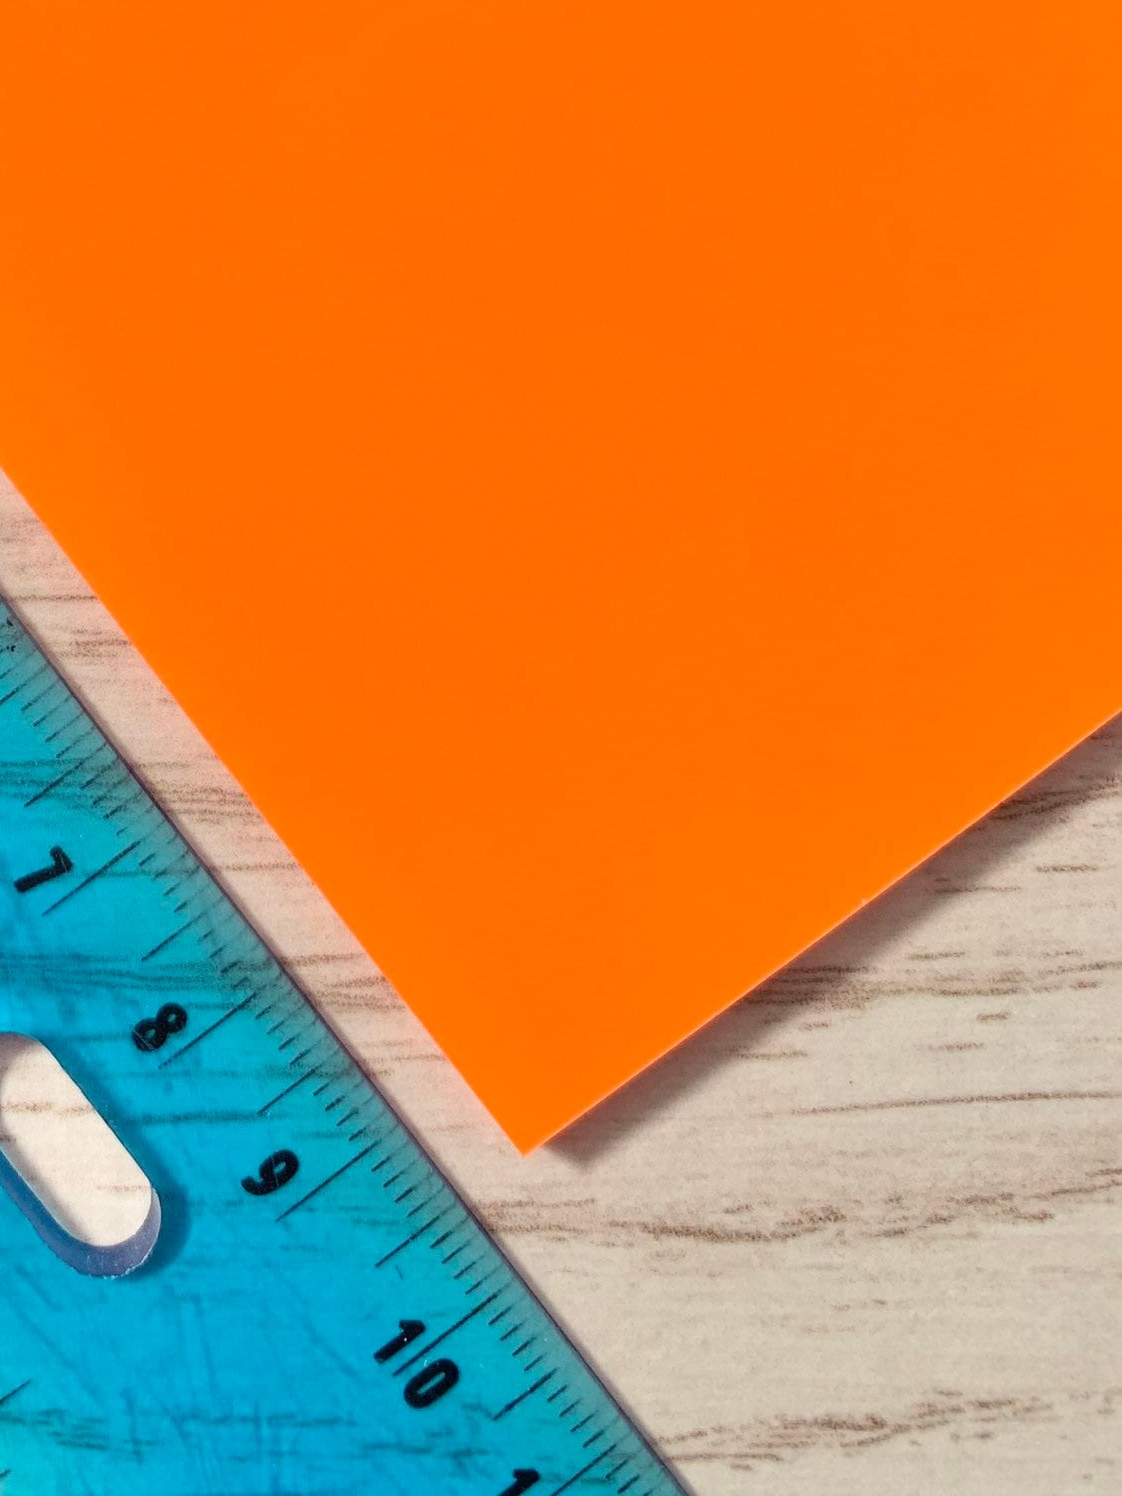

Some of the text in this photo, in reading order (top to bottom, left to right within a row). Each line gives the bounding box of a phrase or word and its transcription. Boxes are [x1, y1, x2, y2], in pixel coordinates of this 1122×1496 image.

[13, 845, 74, 893] 7
[131, 1002, 188, 1053] 8
[241, 1148, 300, 1197] 9
[373, 1318, 461, 1409] 10
